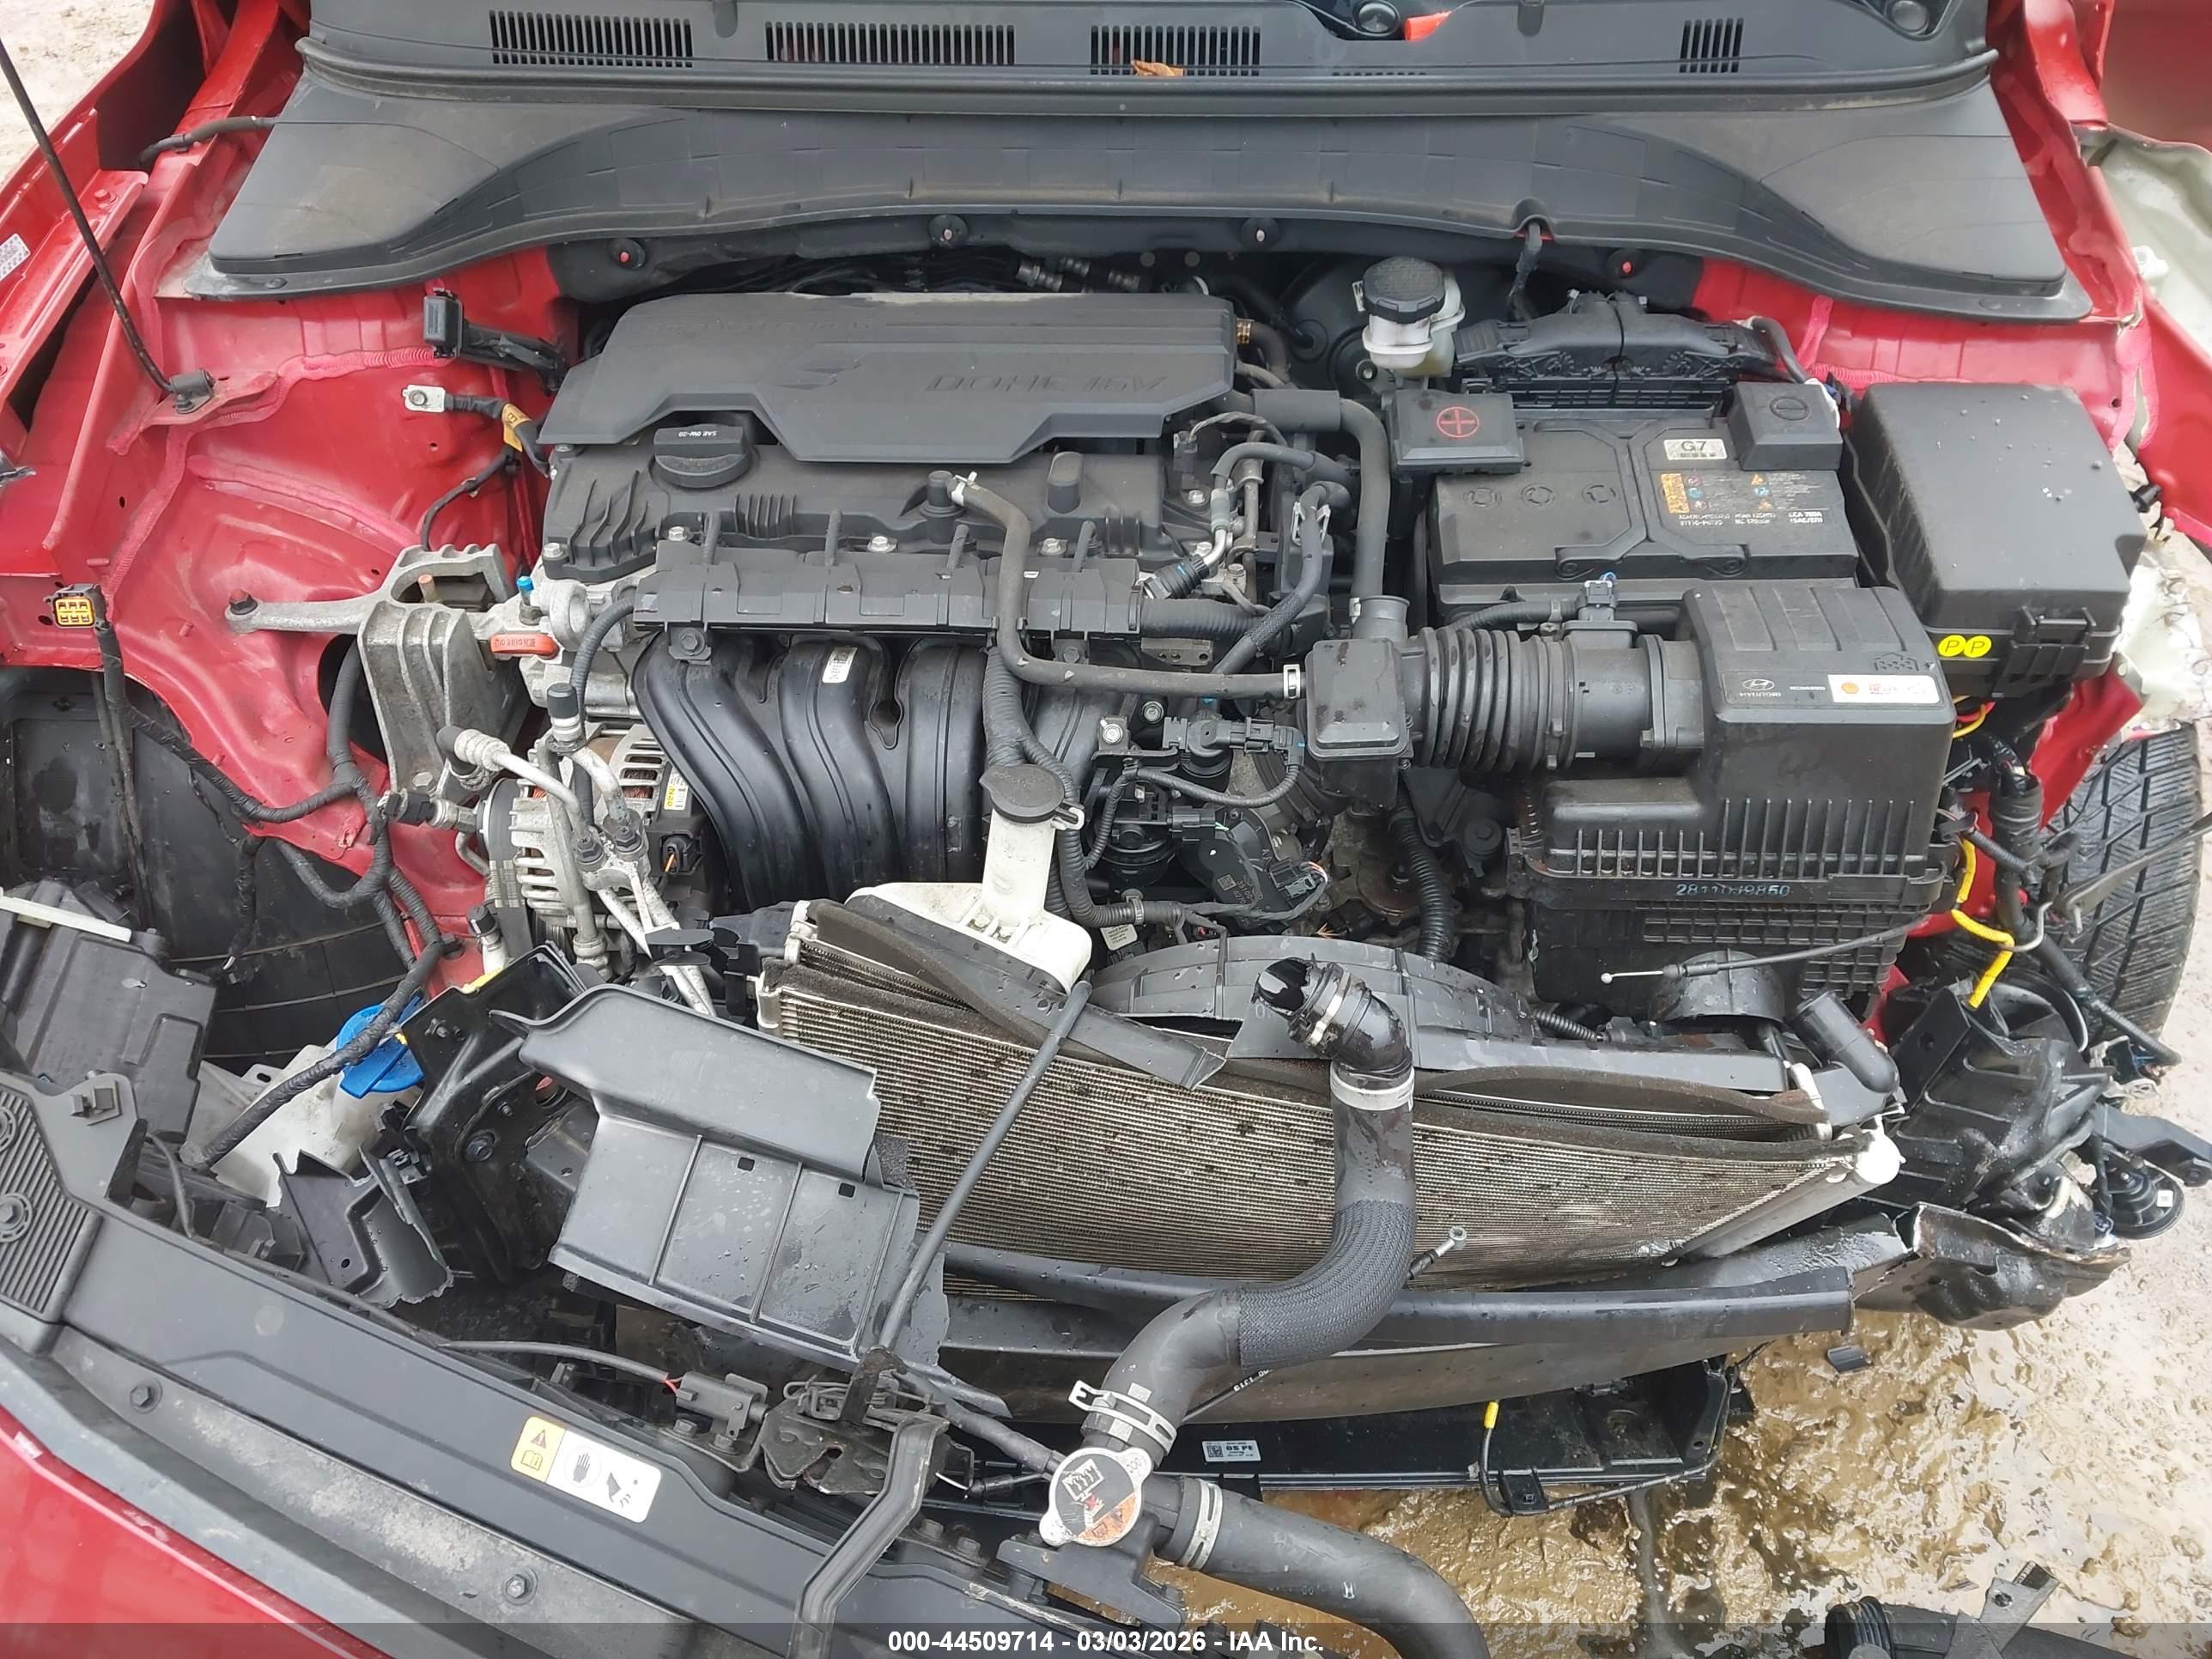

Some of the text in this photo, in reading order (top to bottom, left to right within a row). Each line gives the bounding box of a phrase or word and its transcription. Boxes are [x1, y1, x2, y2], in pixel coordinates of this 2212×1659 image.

[1681, 441, 1707, 452] G7
[1945, 640, 1960, 653] P
[1971, 641, 1985, 653] P
